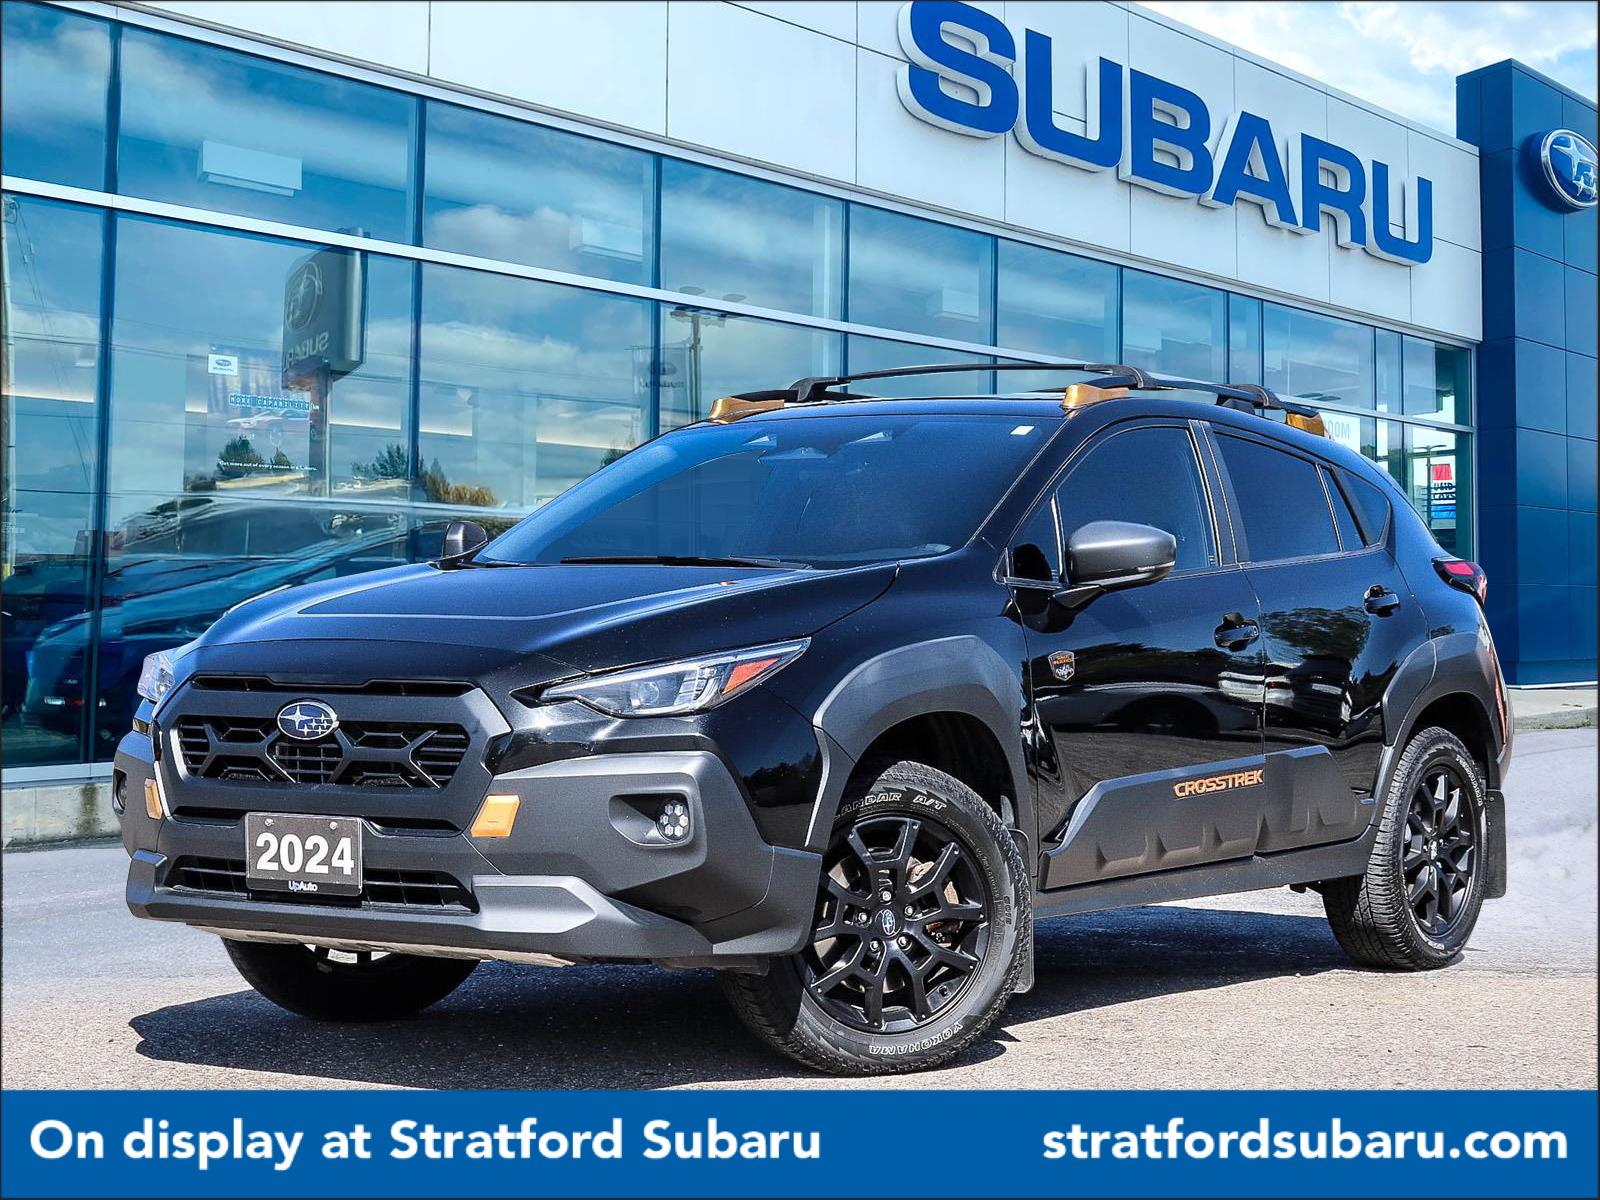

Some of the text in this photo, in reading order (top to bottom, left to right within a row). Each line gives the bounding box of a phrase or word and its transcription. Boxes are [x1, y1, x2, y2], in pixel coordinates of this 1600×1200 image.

[900, 0, 1434, 266] SUBARU
[1173, 769, 1264, 797] CROSSTREK
[912, 794, 947, 810] A/T
[255, 832, 355, 876] 2024
[288, 880, 319, 892] UpAuto
[868, 1021, 963, 1056] YOKOHAMA
